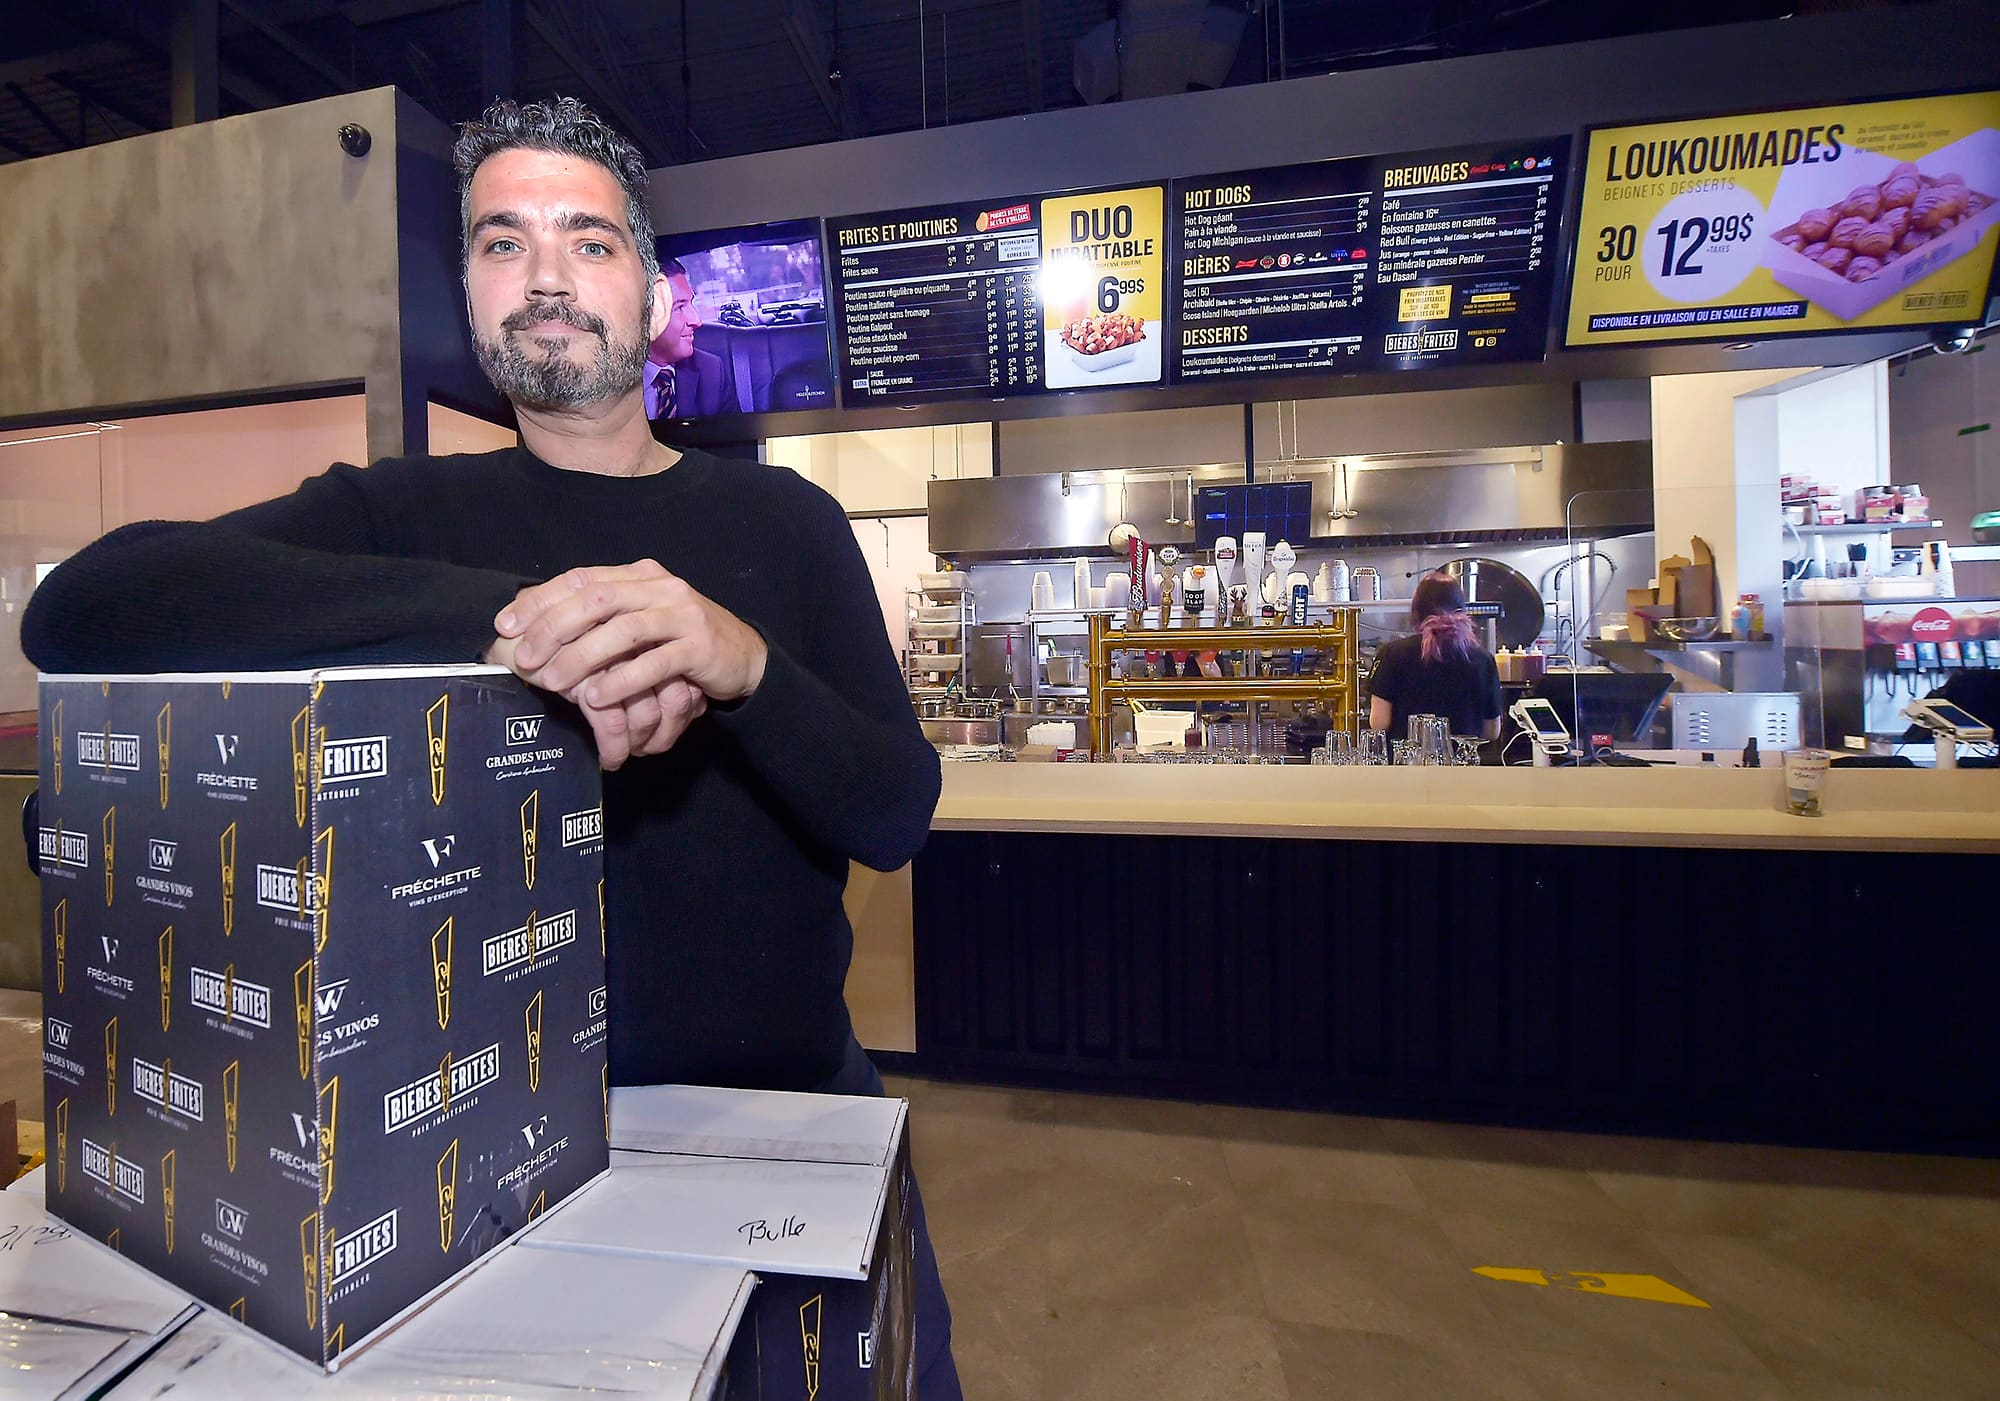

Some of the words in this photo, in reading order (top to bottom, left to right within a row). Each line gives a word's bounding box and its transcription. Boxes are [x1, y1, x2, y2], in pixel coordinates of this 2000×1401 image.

[1606, 123, 1844, 182] LOUKOUMADES
[1384, 162, 1469, 188] BREUVAGES
[1185, 190, 1212, 209] HOT
[1216, 185, 1251, 206] DOGS
[1603, 183, 1665, 201] BEIGNETS
[1670, 176, 1734, 195] DESSERTS
[1383, 200, 1400, 210] Café
[1071, 205, 1132, 243] DUO
[1184, 216, 1197, 226] Hot
[1198, 214, 1212, 225] Dog
[1381, 224, 1414, 235] Boissons
[1415, 220, 1450, 233] gazeuses
[1452, 219, 1461, 229] en
[1463, 216, 1497, 228] canettes
[1382, 213, 1391, 223] En
[1393, 210, 1424, 221] fontaine
[840, 227, 879, 246] FRITES
[882, 224, 897, 240] ET
[900, 218, 958, 238] POUTINES
[1184, 227, 1199, 238] Pain
[1380, 237, 1394, 248] Red
[1396, 235, 1410, 246] Bull
[1184, 239, 1197, 250] Hot
[1198, 238, 1211, 248] Dog
[1212, 236, 1243, 247] Michigan
[1599, 224, 1637, 262] 30
[842, 257, 859, 267] Frites
[1184, 254, 1230, 276] BIÈRES
[1379, 250, 1392, 260] Jus
[1379, 261, 1392, 271] Eau
[1394, 258, 1425, 269] minérale
[1458, 254, 1485, 265] Perrier
[843, 268, 860, 278] Frites
[861, 267, 879, 276] sauce
[1378, 273, 1391, 283] Eau
[1393, 270, 1418, 282] Dasani
[1595, 264, 1632, 284] POUR
[845, 292, 868, 301] Poutine
[868, 290, 886, 299] sauce
[1183, 288, 1197, 298] Bud
[846, 302, 869, 312] Poutine
[1183, 298, 1215, 309] Archibald
[1183, 311, 1202, 321] Goose
[1310, 300, 1327, 311] Stella
[847, 313, 870, 323] Poutine
[870, 311, 889, 322] poulet
[890, 310, 904, 319] sans
[1592, 314, 1638, 329] DISPONIBLE
[1639, 314, 1651, 325] EN
[1652, 311, 1695, 325] LIVRAISON
[1697, 310, 1709, 321] OU
[1710, 309, 1721, 320] EN
[1722, 307, 1749, 319] SALLE
[1750, 307, 1761, 318] EN
[1762, 304, 1800, 317] MANGER
[848, 324, 871, 334] Poutine
[1183, 325, 1248, 346] DESSERTS
[849, 335, 871, 345] Poutine
[1424, 333, 1455, 348] FRITES
[849, 346, 872, 355] Poutine
[851, 356, 873, 366] Poutine
[874, 354, 892, 365] poulet
[893, 352, 920, 363] pop-corn
[1182, 355, 1228, 367] Loukoumades
[109, 740, 138, 765] FRITES
[324, 744, 382, 777] FRITES
[486, 751, 534, 768] GRANDES
[535, 748, 564, 762] VINOS
[196, 771, 258, 792] FRÉCHETTE
[61, 836, 85, 861] FRITES
[136, 876, 172, 893] GRANDES
[392, 866, 482, 900] FRÉCHETTE
[535, 916, 571, 949] FRITES
[87, 966, 134, 992] FRÉCHETTE
[232, 986, 268, 1020] FRITES
[334, 1013, 380, 1040] VINOS
[450, 1052, 495, 1095] FRITES
[169, 1076, 202, 1114] FRITES
[497, 1136, 569, 1191] FRÉCHETTE
[115, 1155, 143, 1197] FRITES
[202, 1233, 239, 1260] GRANDES
[334, 1219, 392, 1277] FRITES
